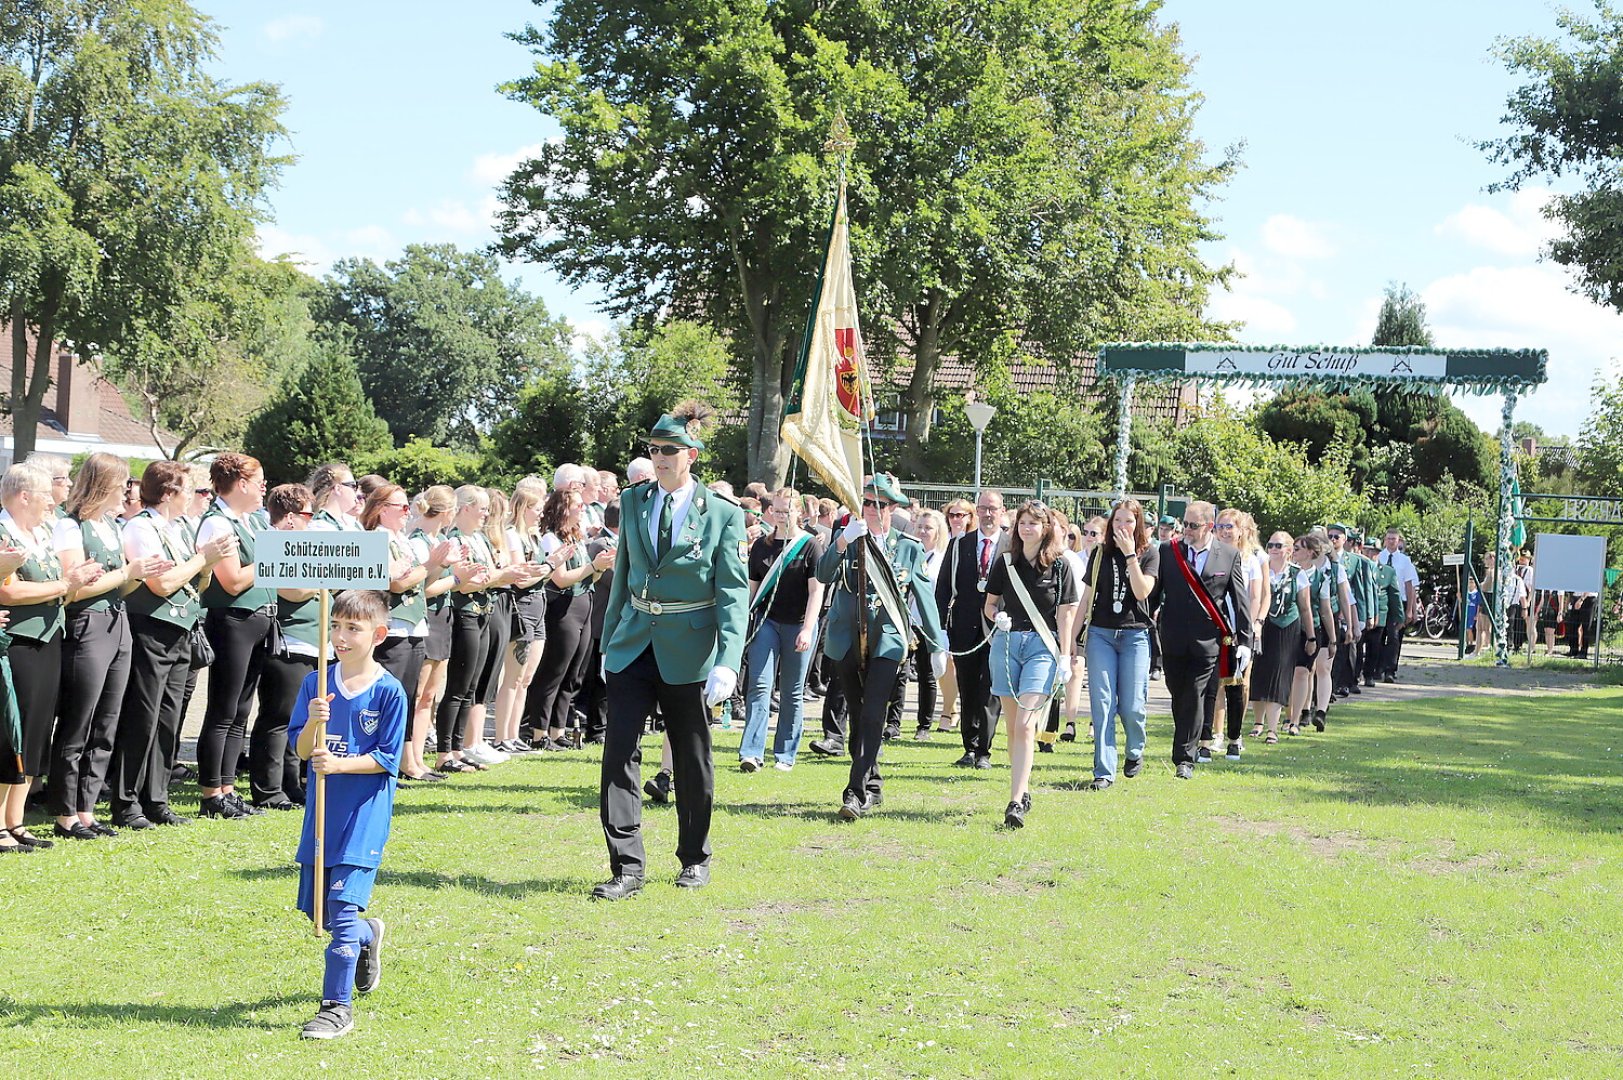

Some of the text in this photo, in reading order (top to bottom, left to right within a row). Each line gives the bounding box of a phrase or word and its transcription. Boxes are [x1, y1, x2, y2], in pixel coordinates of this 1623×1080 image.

[1267, 351, 1359, 374] Gut Schuß
[284, 541, 360, 557] Schützenverein
[258, 562, 386, 581] Gut Ziel Strücklingen e.V.
